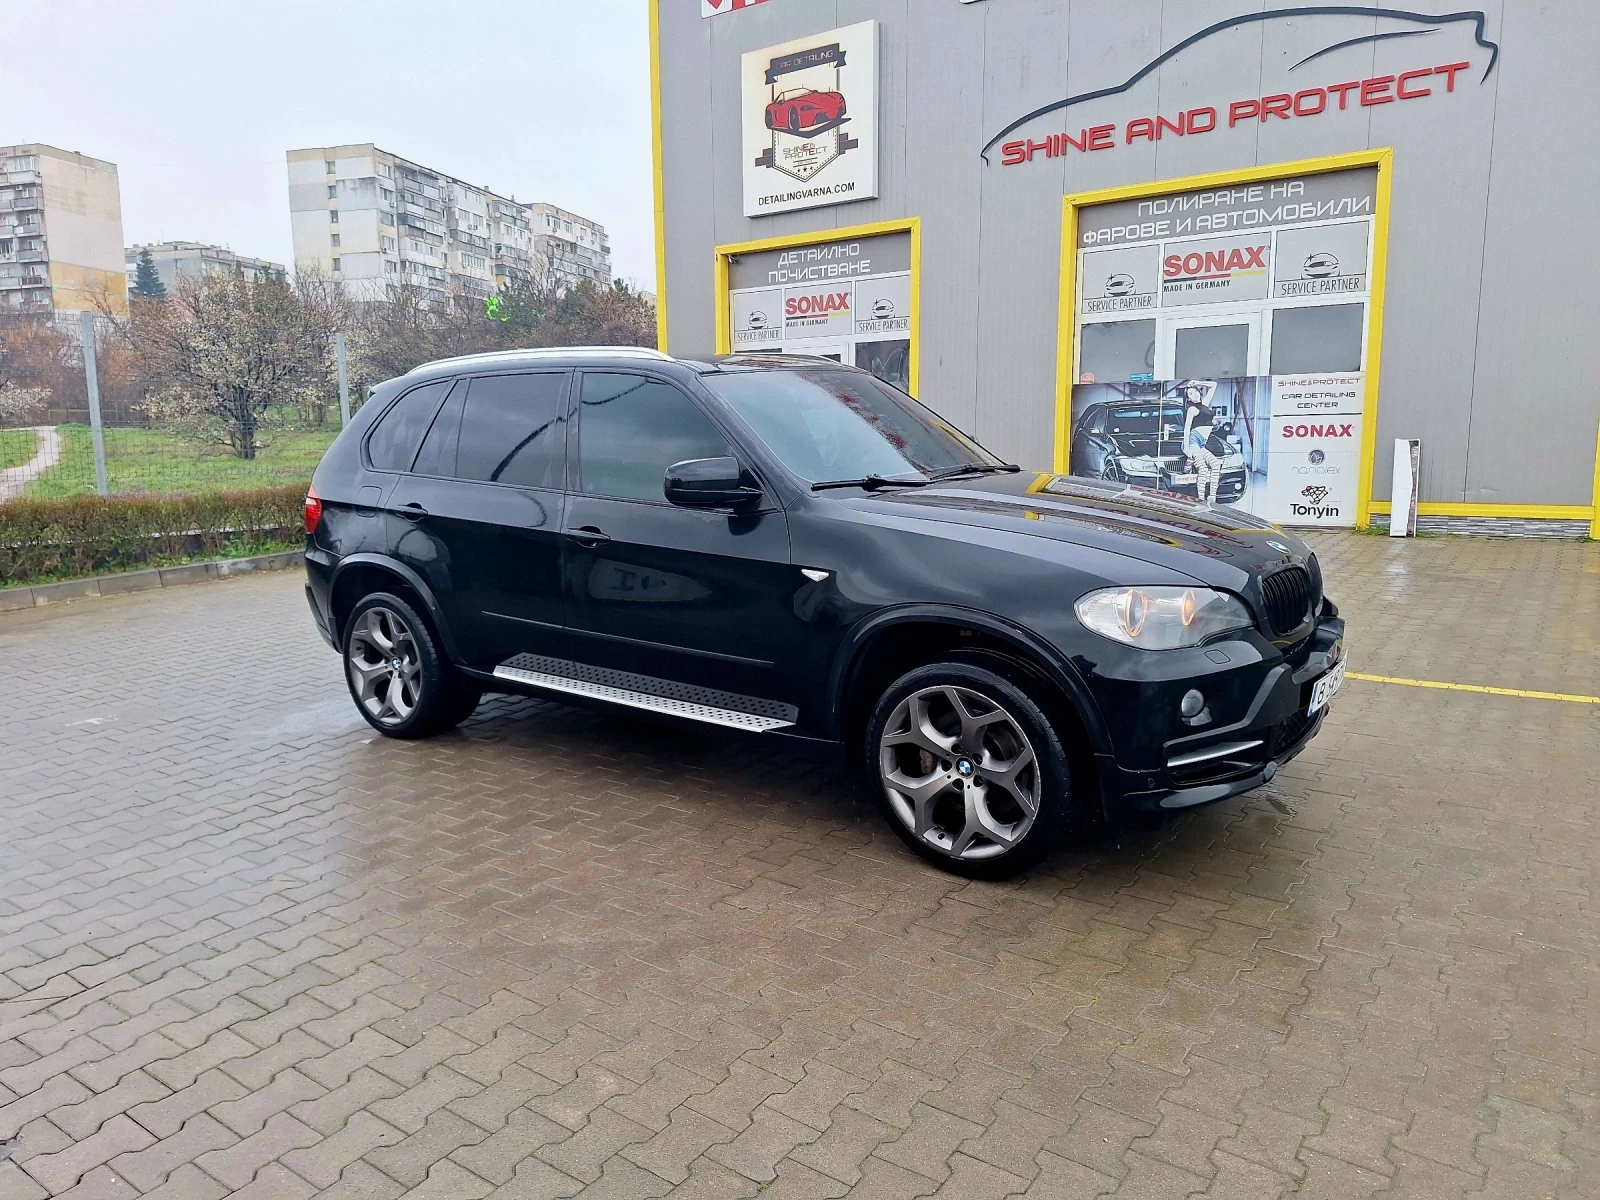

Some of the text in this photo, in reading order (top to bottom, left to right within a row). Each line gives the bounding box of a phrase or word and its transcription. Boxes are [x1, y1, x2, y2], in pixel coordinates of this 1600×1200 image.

[1001, 61, 1470, 166] SHINE AND PROTECT
[758, 182, 855, 206] DETAILINGVARNA.COM
[1137, 180, 1304, 217] ПОЛИРАНЕ НА
[1083, 195, 1370, 244] ФАРОВЕ И АВТОМОБИЛИ
[777, 242, 860, 268] ДЕТАЙЛНО
[1163, 245, 1267, 278] SONAX
[768, 259, 871, 284] ПОЧИСТВАНЕ
[1163, 279, 1231, 293] MADE IN GERMANY
[1280, 277, 1360, 296] SERVICE PARTNER
[785, 292, 850, 315] SONAX
[1087, 296, 1152, 312] SERVICE PARTNER
[785, 320, 799, 328] MADE
[858, 318, 909, 332] SERVICE PARTNER
[737, 329, 780, 342] SERVICE PARTNER
[1278, 378, 1361, 387] SHINE&PROTECT
[1304, 391, 1356, 399] DETAILING
[1297, 401, 1339, 409] CENTER
[1282, 424, 1353, 438] SONAX
[1289, 503, 1339, 519] Tonyin
